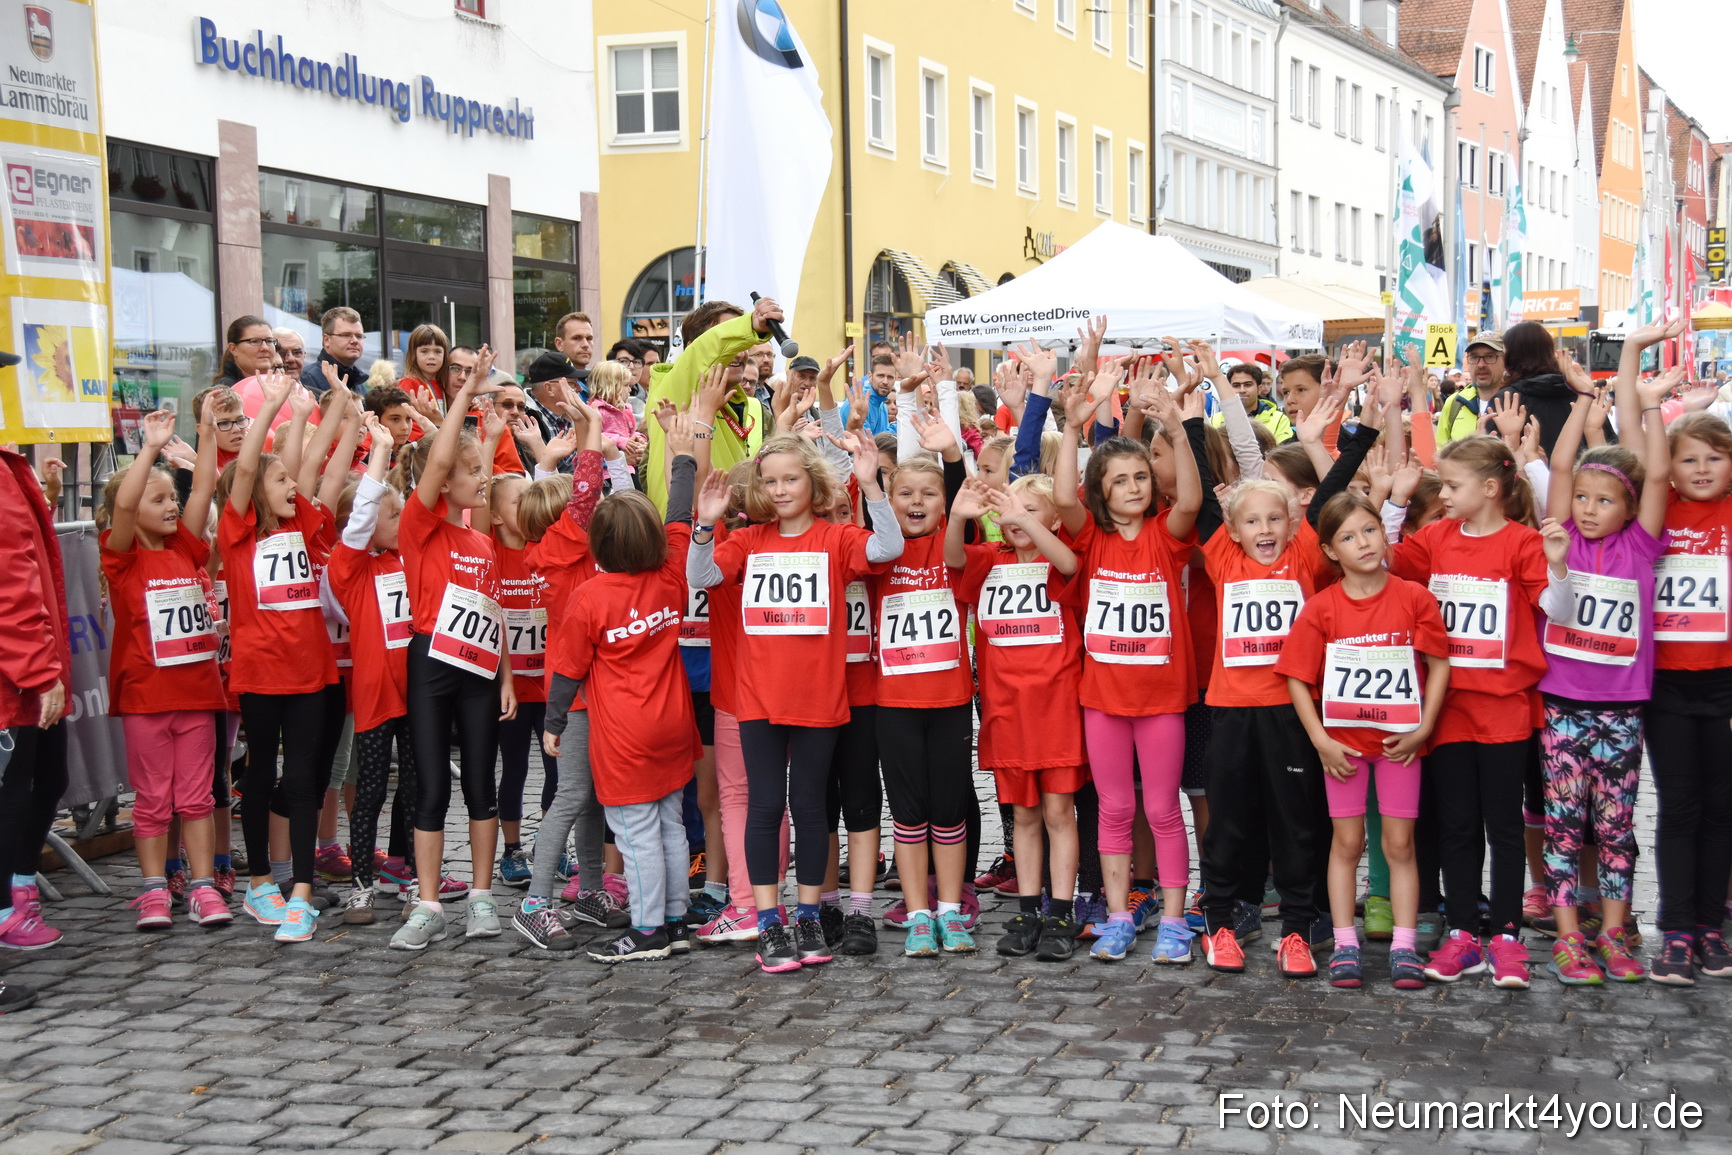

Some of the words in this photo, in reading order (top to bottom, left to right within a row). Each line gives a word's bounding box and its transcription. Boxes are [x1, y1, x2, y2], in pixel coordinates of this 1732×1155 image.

[9, 65, 76, 93] Neumarkter
[196, 16, 411, 122] Buchhandlung
[419, 75, 534, 140] Rupprecht
[0, 83, 88, 121] Lammsbräu
[36, 197, 93, 214] PFLASTERSTEINE
[1708, 229, 1726, 280] HOT
[939, 313, 977, 326] BMW
[980, 307, 1090, 323] ConnectedDrive
[940, 328, 983, 337] Vernetzt,
[985, 327, 1000, 335] um
[1001, 325, 1017, 334] frei
[1032, 324, 1055, 332] sein.
[1429, 325, 1454, 334] Block
[1431, 336, 1449, 358] A
[779, 555, 821, 566] BOCK
[1670, 558, 1718, 569] BOCK
[1007, 566, 1048, 577] BOCK
[287, 587, 311, 599] Carla
[752, 572, 818, 604] 7061
[1124, 585, 1164, 596] BOCK
[1256, 582, 1296, 593] BOCK
[1453, 583, 1499, 596] BOCK
[1594, 578, 1638, 594] BOCK
[1654, 576, 1720, 608] 424
[154, 595, 182, 604] NeuerMarkt
[909, 592, 949, 604] BOCK
[986, 583, 1052, 616] 7220
[159, 603, 213, 636] 7095
[763, 610, 806, 623] Victoria
[1096, 600, 1165, 634] 7105
[1231, 600, 1299, 633] 7087
[1574, 593, 1635, 633] 078
[448, 604, 500, 650] 7074
[649, 617, 680, 637] energie
[887, 608, 954, 644] 7412
[994, 623, 1040, 636] Johanna
[186, 639, 206, 652] Leni
[1110, 639, 1146, 653] Emilia
[1334, 633, 1388, 646] eumarkter
[1564, 632, 1617, 653] Marlene
[459, 645, 479, 662] Lisa
[896, 647, 926, 661] Tonia
[1333, 654, 1361, 662] NeuerMarkt
[1366, 649, 1408, 661] BOCK
[1334, 666, 1413, 700] 7224
[1356, 707, 1388, 721] Julia
